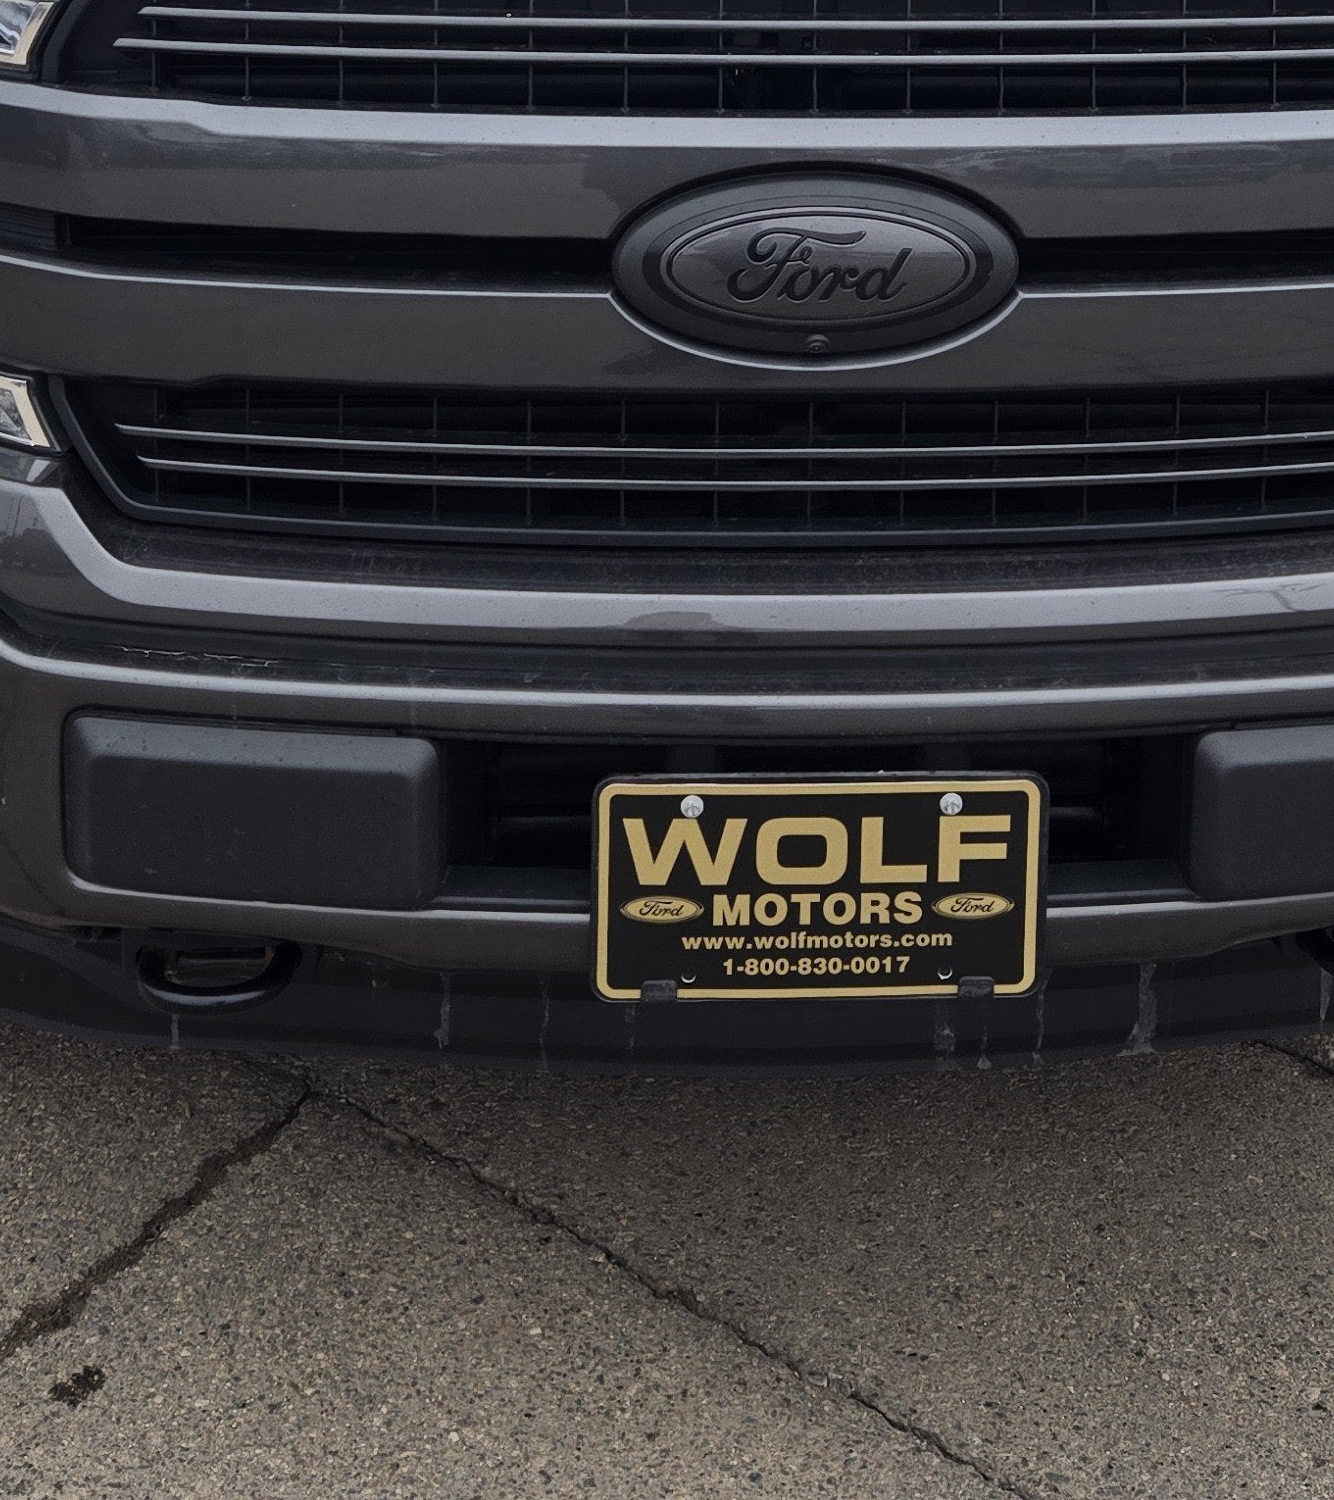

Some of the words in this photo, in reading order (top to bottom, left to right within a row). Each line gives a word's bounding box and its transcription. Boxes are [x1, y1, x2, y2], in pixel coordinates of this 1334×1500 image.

[726, 226, 913, 304] Ford
[622, 814, 1012, 886] WOLF
[637, 900, 685, 919] Ford
[712, 891, 923, 927] MOTORS
[949, 896, 998, 915] Ford
[681, 930, 953, 951] www.wolfmotors.com
[722, 956, 911, 976] 1-800-830-0017
